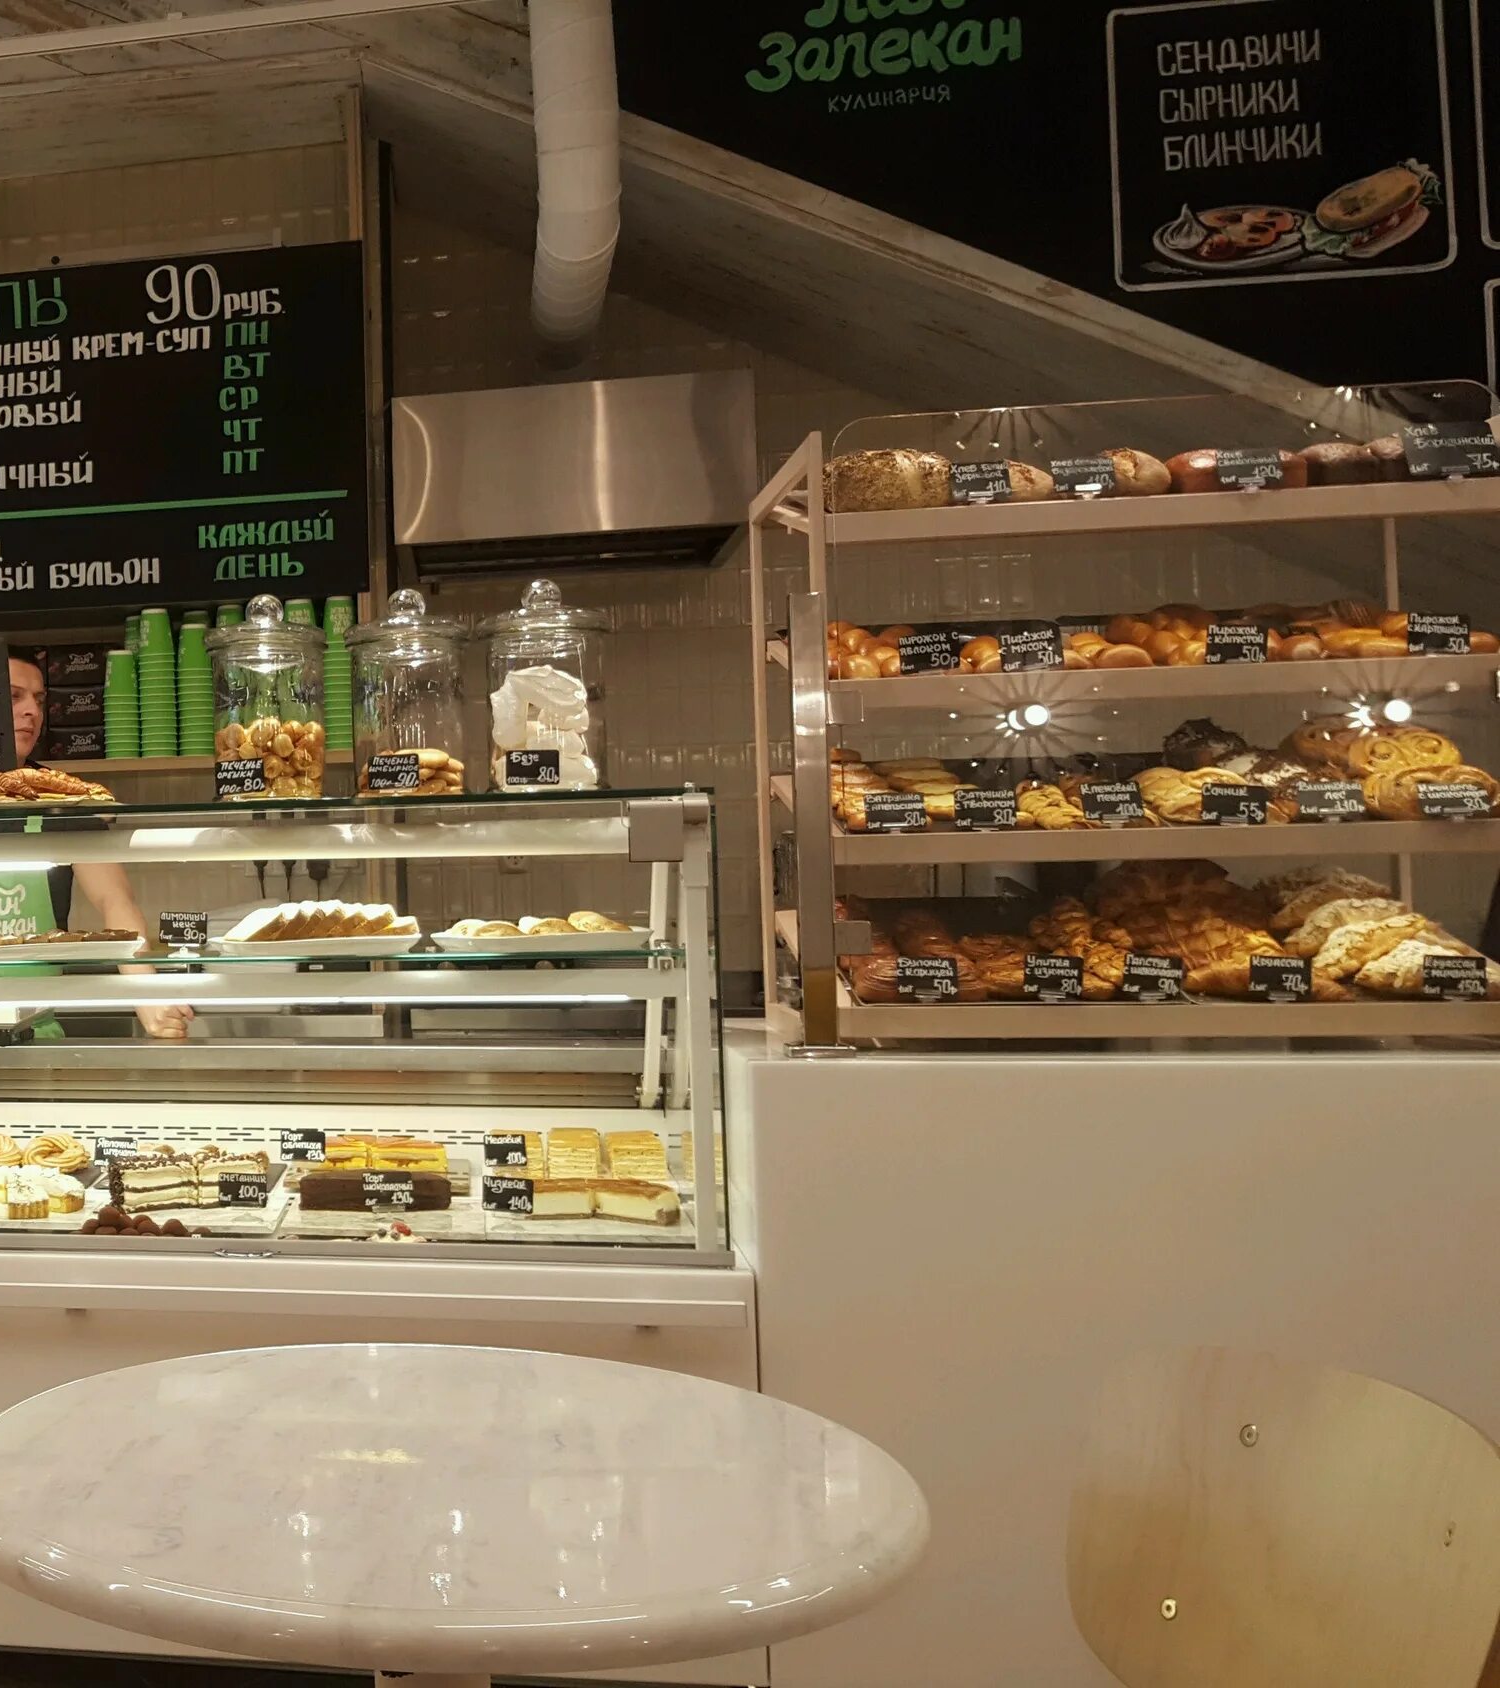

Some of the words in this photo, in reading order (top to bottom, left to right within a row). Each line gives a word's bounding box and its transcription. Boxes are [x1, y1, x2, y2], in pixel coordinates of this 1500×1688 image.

[745, 17, 1022, 93] Запекан
[1157, 28, 1321, 76] СЕНДВИЧИ
[1159, 78, 1299, 124] СЫРНИКИ
[1163, 121, 1323, 171] БЛИНЧИКИ
[144, 263, 219, 324] 90
[72, 325, 211, 361] КРЕМ-СУП
[225, 320, 269, 347] ПН
[223, 352, 271, 380] ВТ
[219, 386, 259, 412] СР
[223, 418, 262, 443] ЧТ
[222, 448, 264, 475] ПТ
[198, 509, 335, 550] КАЖДЫЙ
[49, 557, 161, 590] БУЛЬОН
[213, 551, 305, 583] ДЕНЬ
